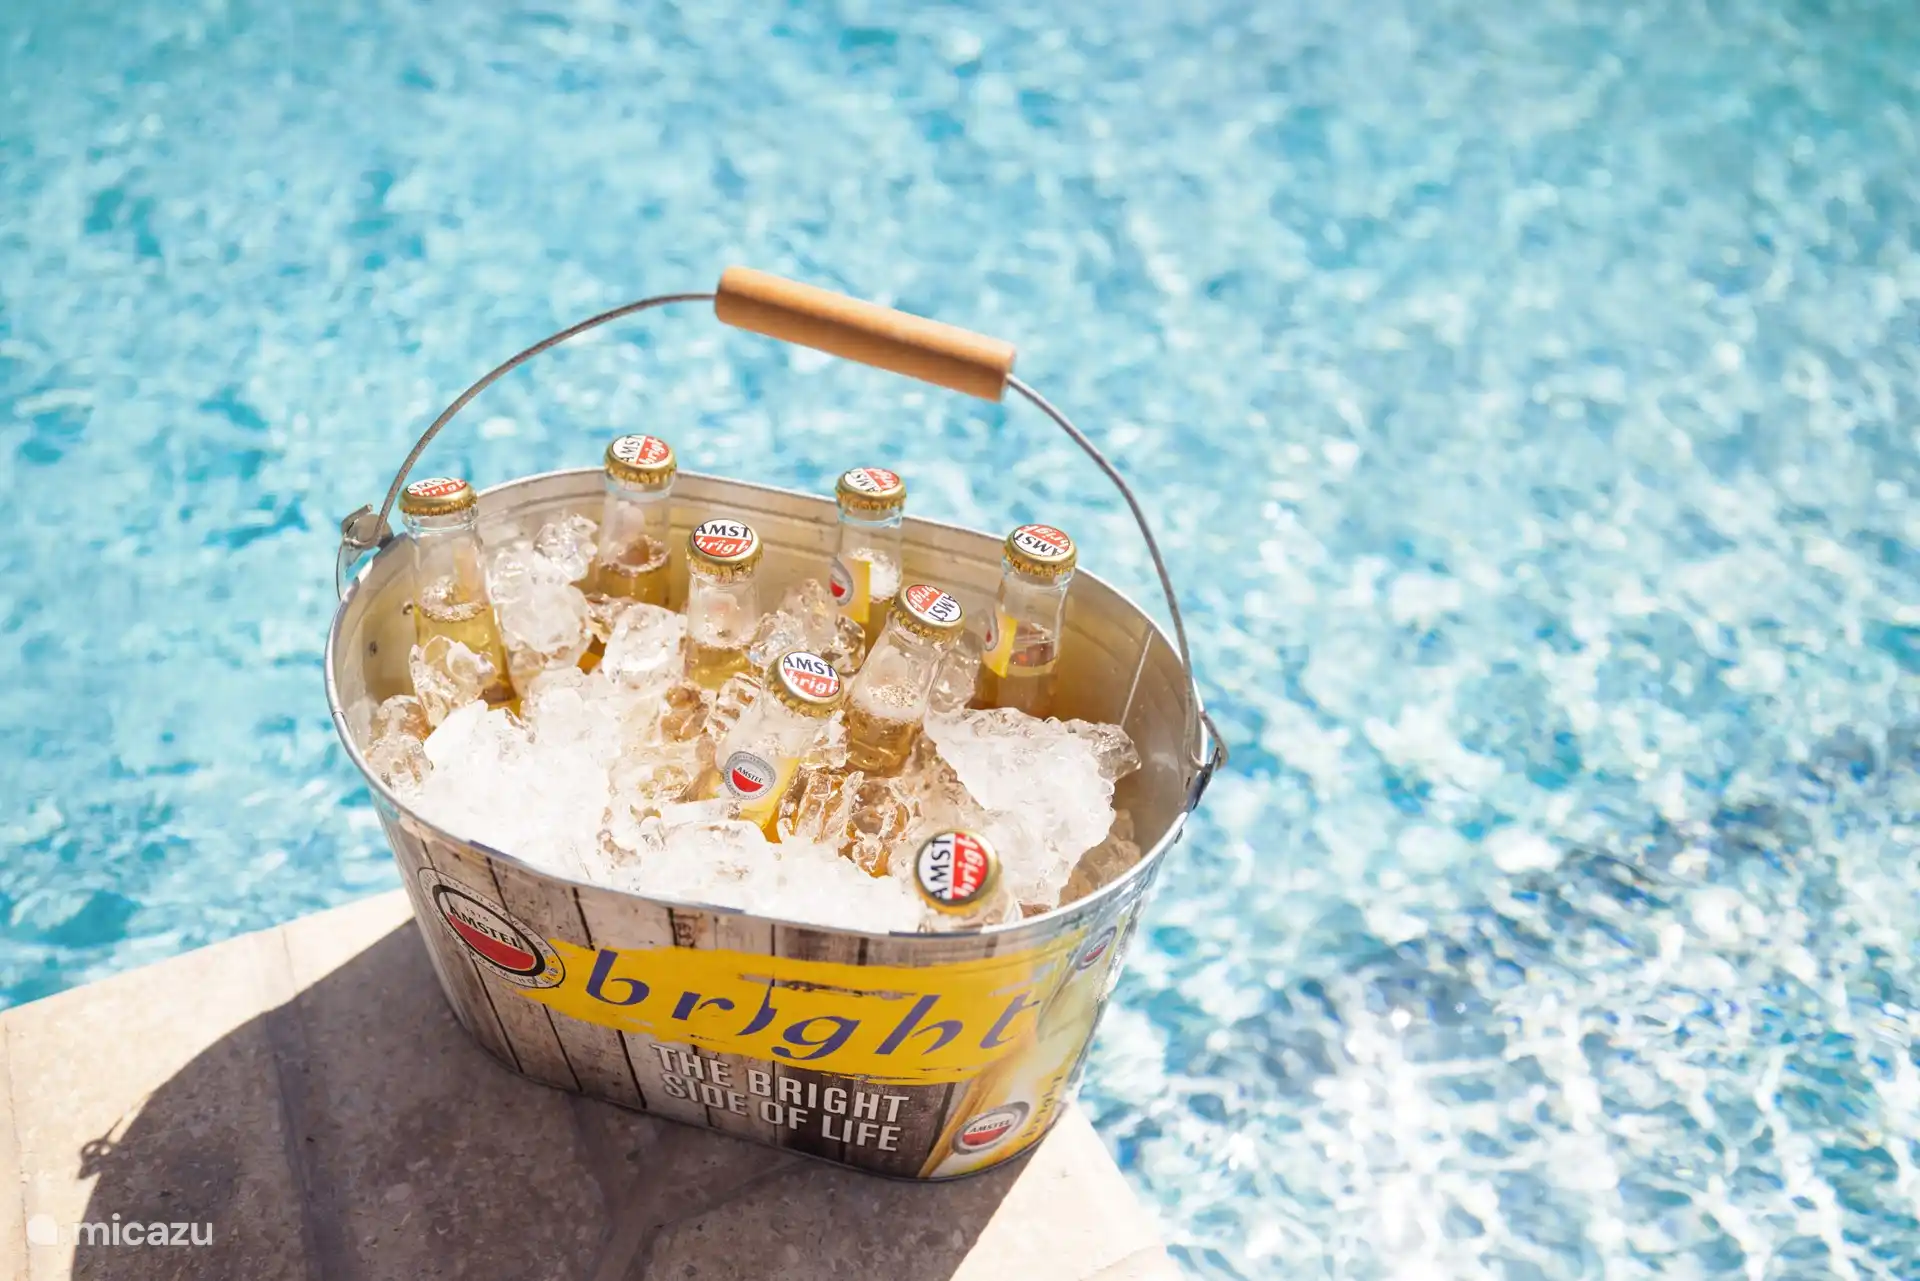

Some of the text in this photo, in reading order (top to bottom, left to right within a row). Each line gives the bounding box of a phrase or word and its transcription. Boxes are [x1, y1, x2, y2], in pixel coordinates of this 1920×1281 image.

[737, 766, 763, 783] AMSTEL
[449, 905, 524, 951] AMSTEL
[585, 949, 1041, 1061] bright
[651, 1043, 910, 1123] THE BRIGHT
[662, 1071, 902, 1152] SIDE OF LIFE
[969, 1120, 1010, 1133] AMSTEL
